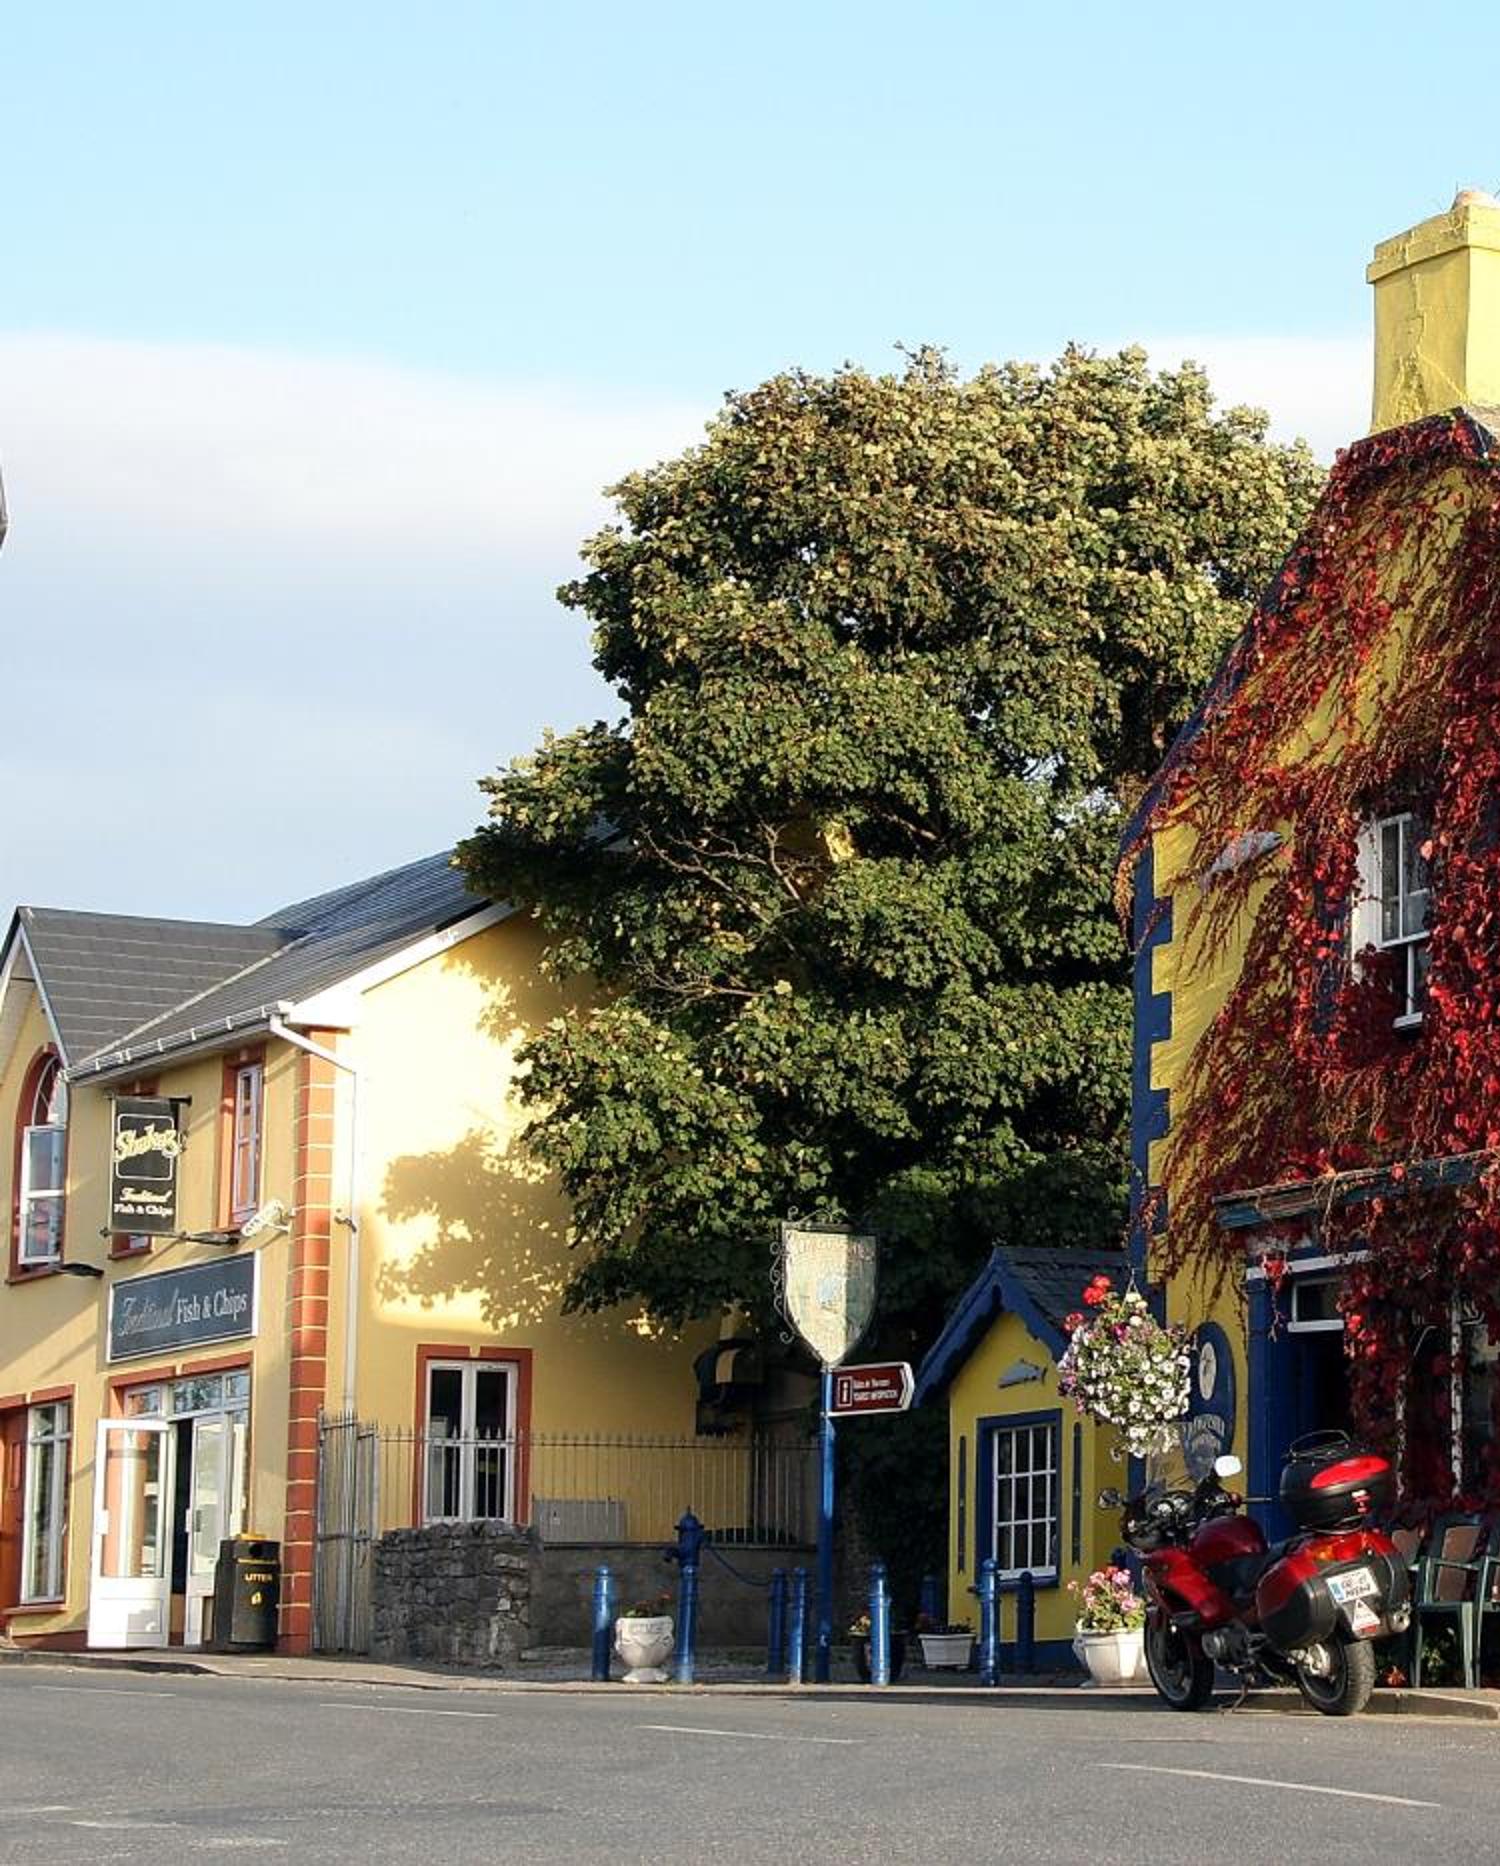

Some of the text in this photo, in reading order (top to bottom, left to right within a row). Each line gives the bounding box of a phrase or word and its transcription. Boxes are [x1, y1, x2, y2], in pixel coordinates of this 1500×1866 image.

[175, 1294, 201, 1325] Fish
[202, 1295, 212, 1319] &
[213, 1288, 248, 1322] Chips
